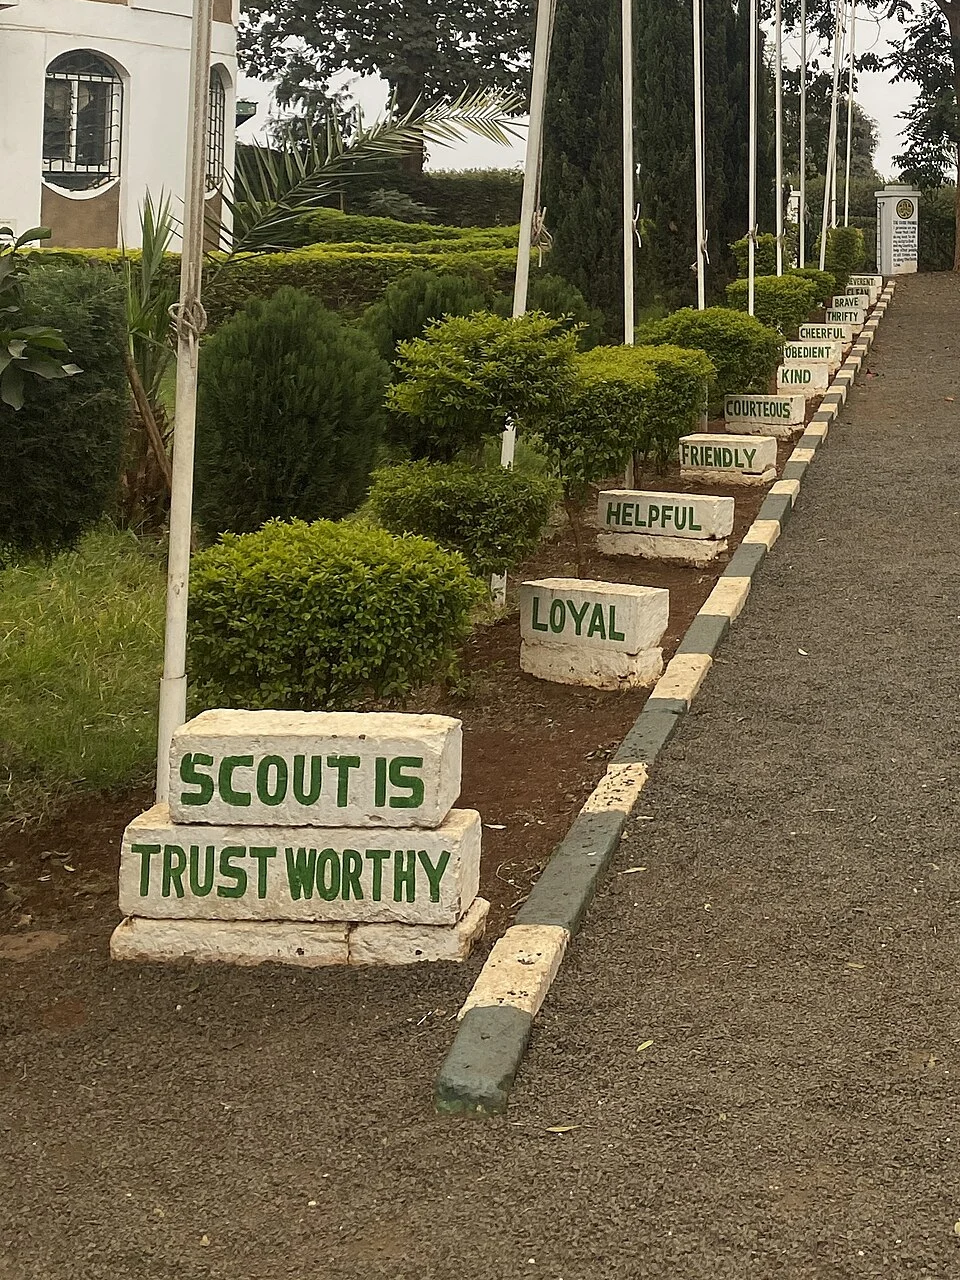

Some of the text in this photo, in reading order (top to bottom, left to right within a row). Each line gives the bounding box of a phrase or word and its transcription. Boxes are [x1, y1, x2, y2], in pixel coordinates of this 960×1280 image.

[848, 277, 875, 286] EVERENT
[834, 297, 859, 308] BRAVE
[827, 310, 859, 322] THRIFTY
[800, 327, 846, 340] CHEERFUL
[785, 345, 832, 359] OBEDIENT
[781, 368, 812, 384] KIND
[726, 399, 791, 419] COURTEOUS
[682, 444, 757, 468] FRIENDLY
[606, 502, 702, 531] HELPFUL
[531, 596, 625, 642] LOYAL
[179, 752, 425, 809] SCOUT IS
